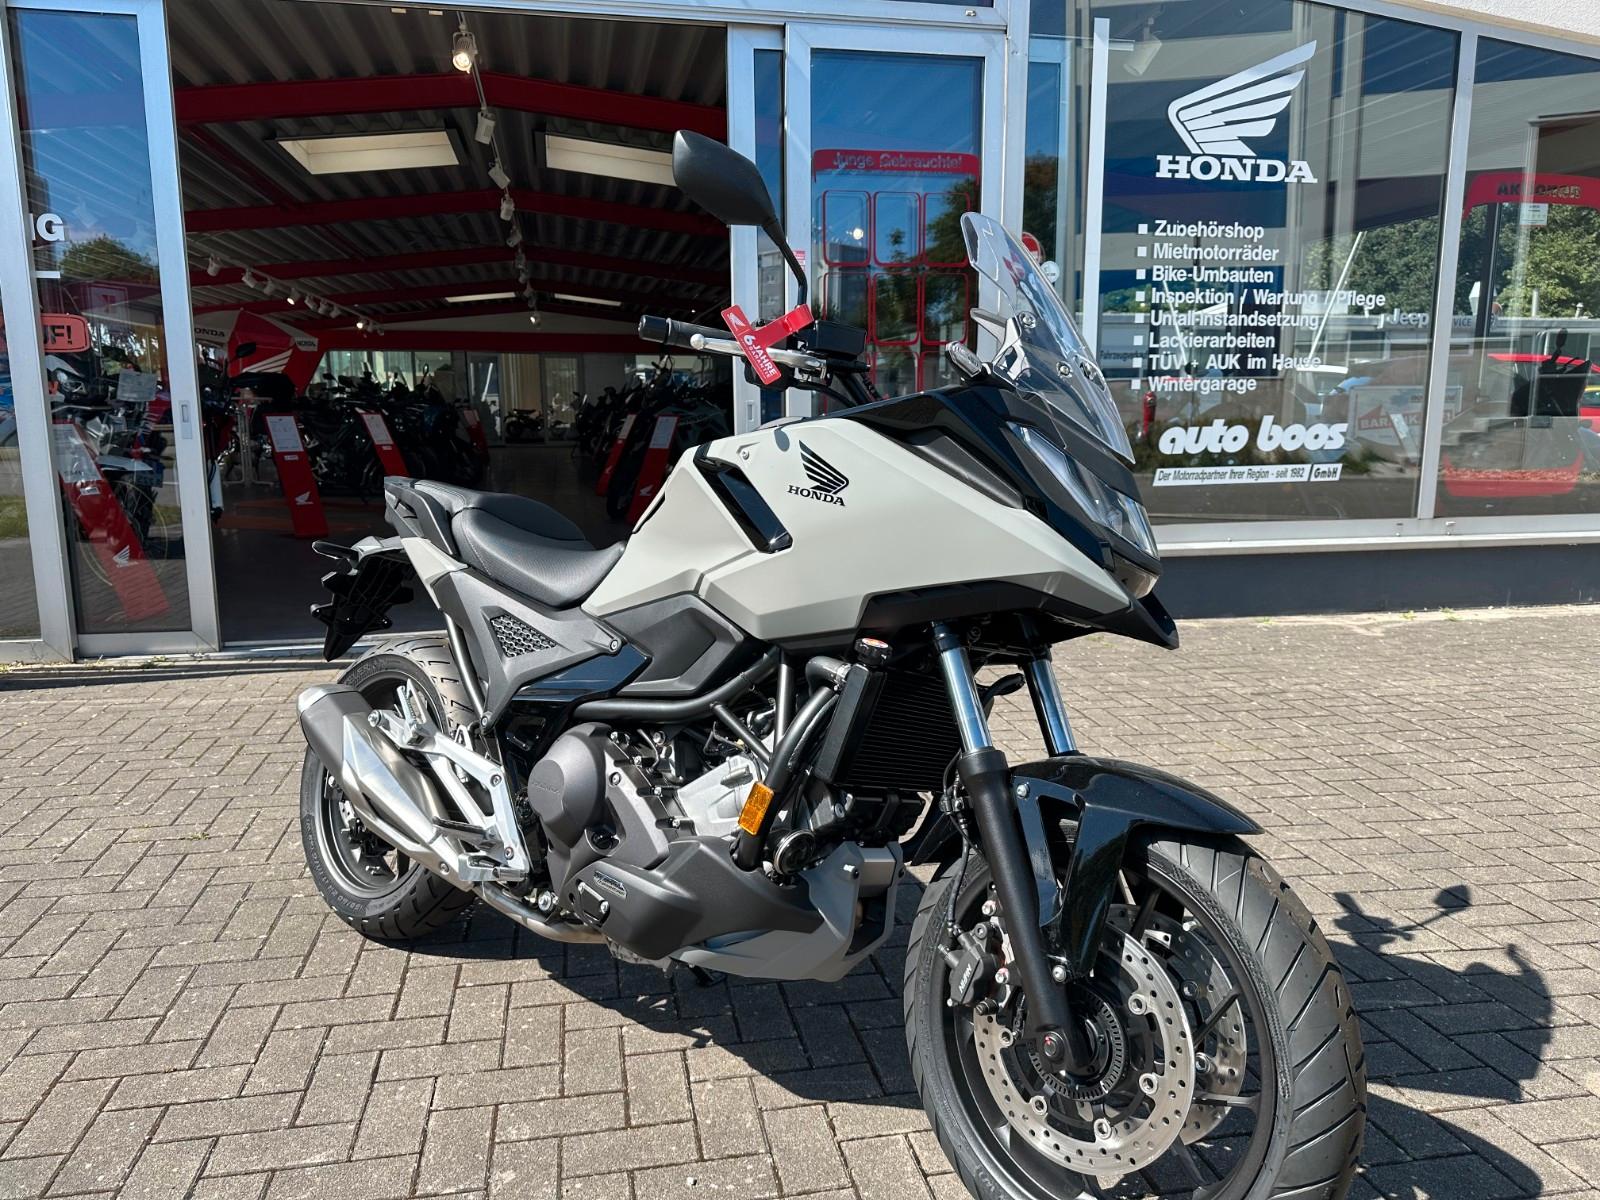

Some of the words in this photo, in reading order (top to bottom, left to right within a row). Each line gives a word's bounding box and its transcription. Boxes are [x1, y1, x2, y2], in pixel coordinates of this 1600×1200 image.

[1155, 154, 1318, 184] HONDA
[29, 213, 65, 241] G
[1154, 220, 1265, 242] Zubehörshop
[1153, 242, 1280, 261] Mietmotorräder
[1152, 265, 1274, 283] Bike-Umbauten
[1150, 287, 1235, 308] Inspektion
[1253, 288, 1318, 307] Wartung
[1337, 289, 1386, 310] Pflege
[1150, 309, 1320, 331] Unfall-Instandsetzung
[1390, 308, 1430, 328] Jeep
[1149, 331, 1276, 349] Lackierarbeiten
[743, 334, 756, 346] 6
[752, 343, 778, 377] JAHRE
[1148, 351, 1186, 371] TÜV
[1205, 353, 1242, 370] AUK
[1246, 353, 1267, 370] im
[1272, 353, 1322, 371] Hause
[1147, 375, 1257, 395] Wintergarage
[1158, 418, 1250, 455] auto
[1256, 415, 1349, 452] boos
[1157, 470, 1170, 481] Der
[1172, 467, 1228, 482] Motorradpartner
[1229, 469, 1246, 479] Ihrer
[1248, 468, 1270, 482] Region
[1275, 467, 1289, 478] seit
[1290, 467, 1305, 478] 1982
[1313, 466, 1338, 479] GmbH
[787, 484, 846, 507] HONDA
